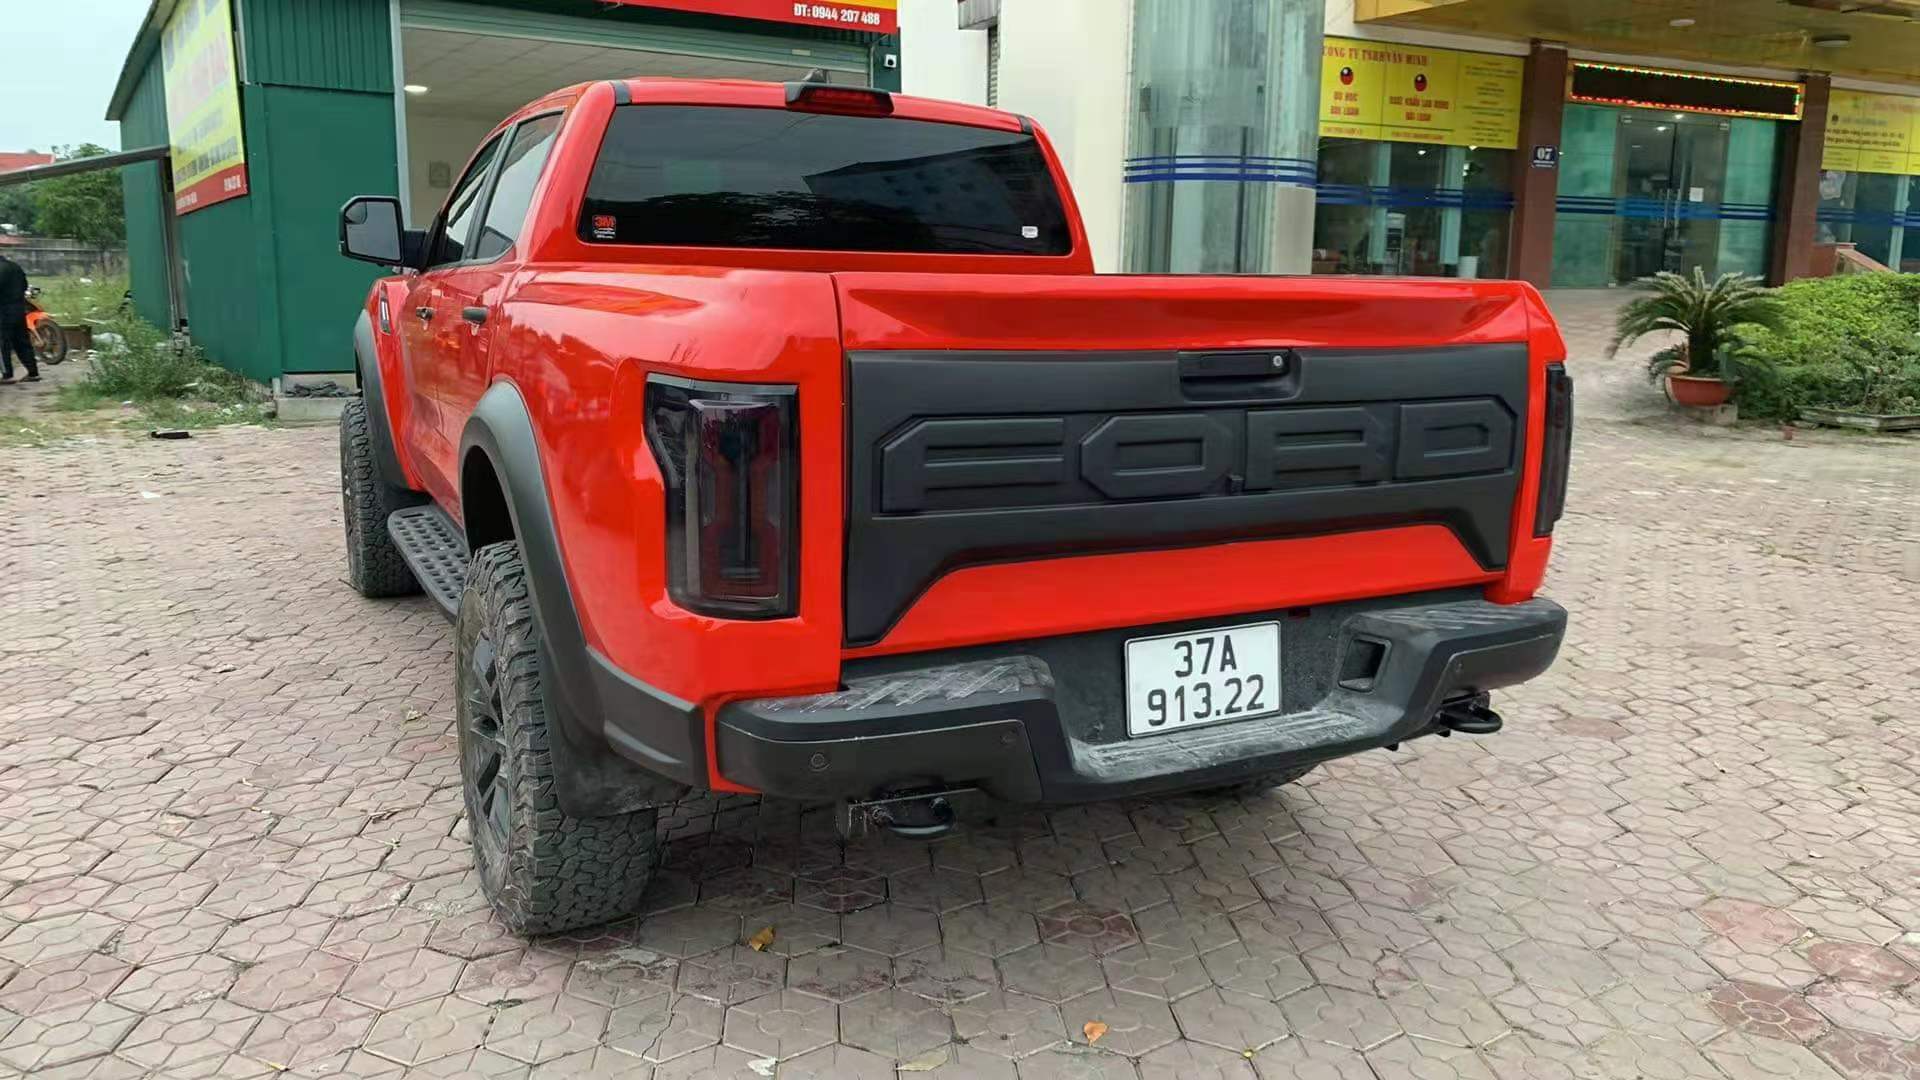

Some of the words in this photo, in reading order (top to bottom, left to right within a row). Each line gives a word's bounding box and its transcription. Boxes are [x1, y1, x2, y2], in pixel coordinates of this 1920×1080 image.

[811, 5, 838, 21] 0944
[839, 8, 860, 23] 207
[1536, 147, 1553, 160] 07
[594, 215, 615, 228] 3M
[879, 396, 1516, 514] FORD
[1174, 635, 1237, 678] 37A
[1147, 674, 1265, 727] 913.22
